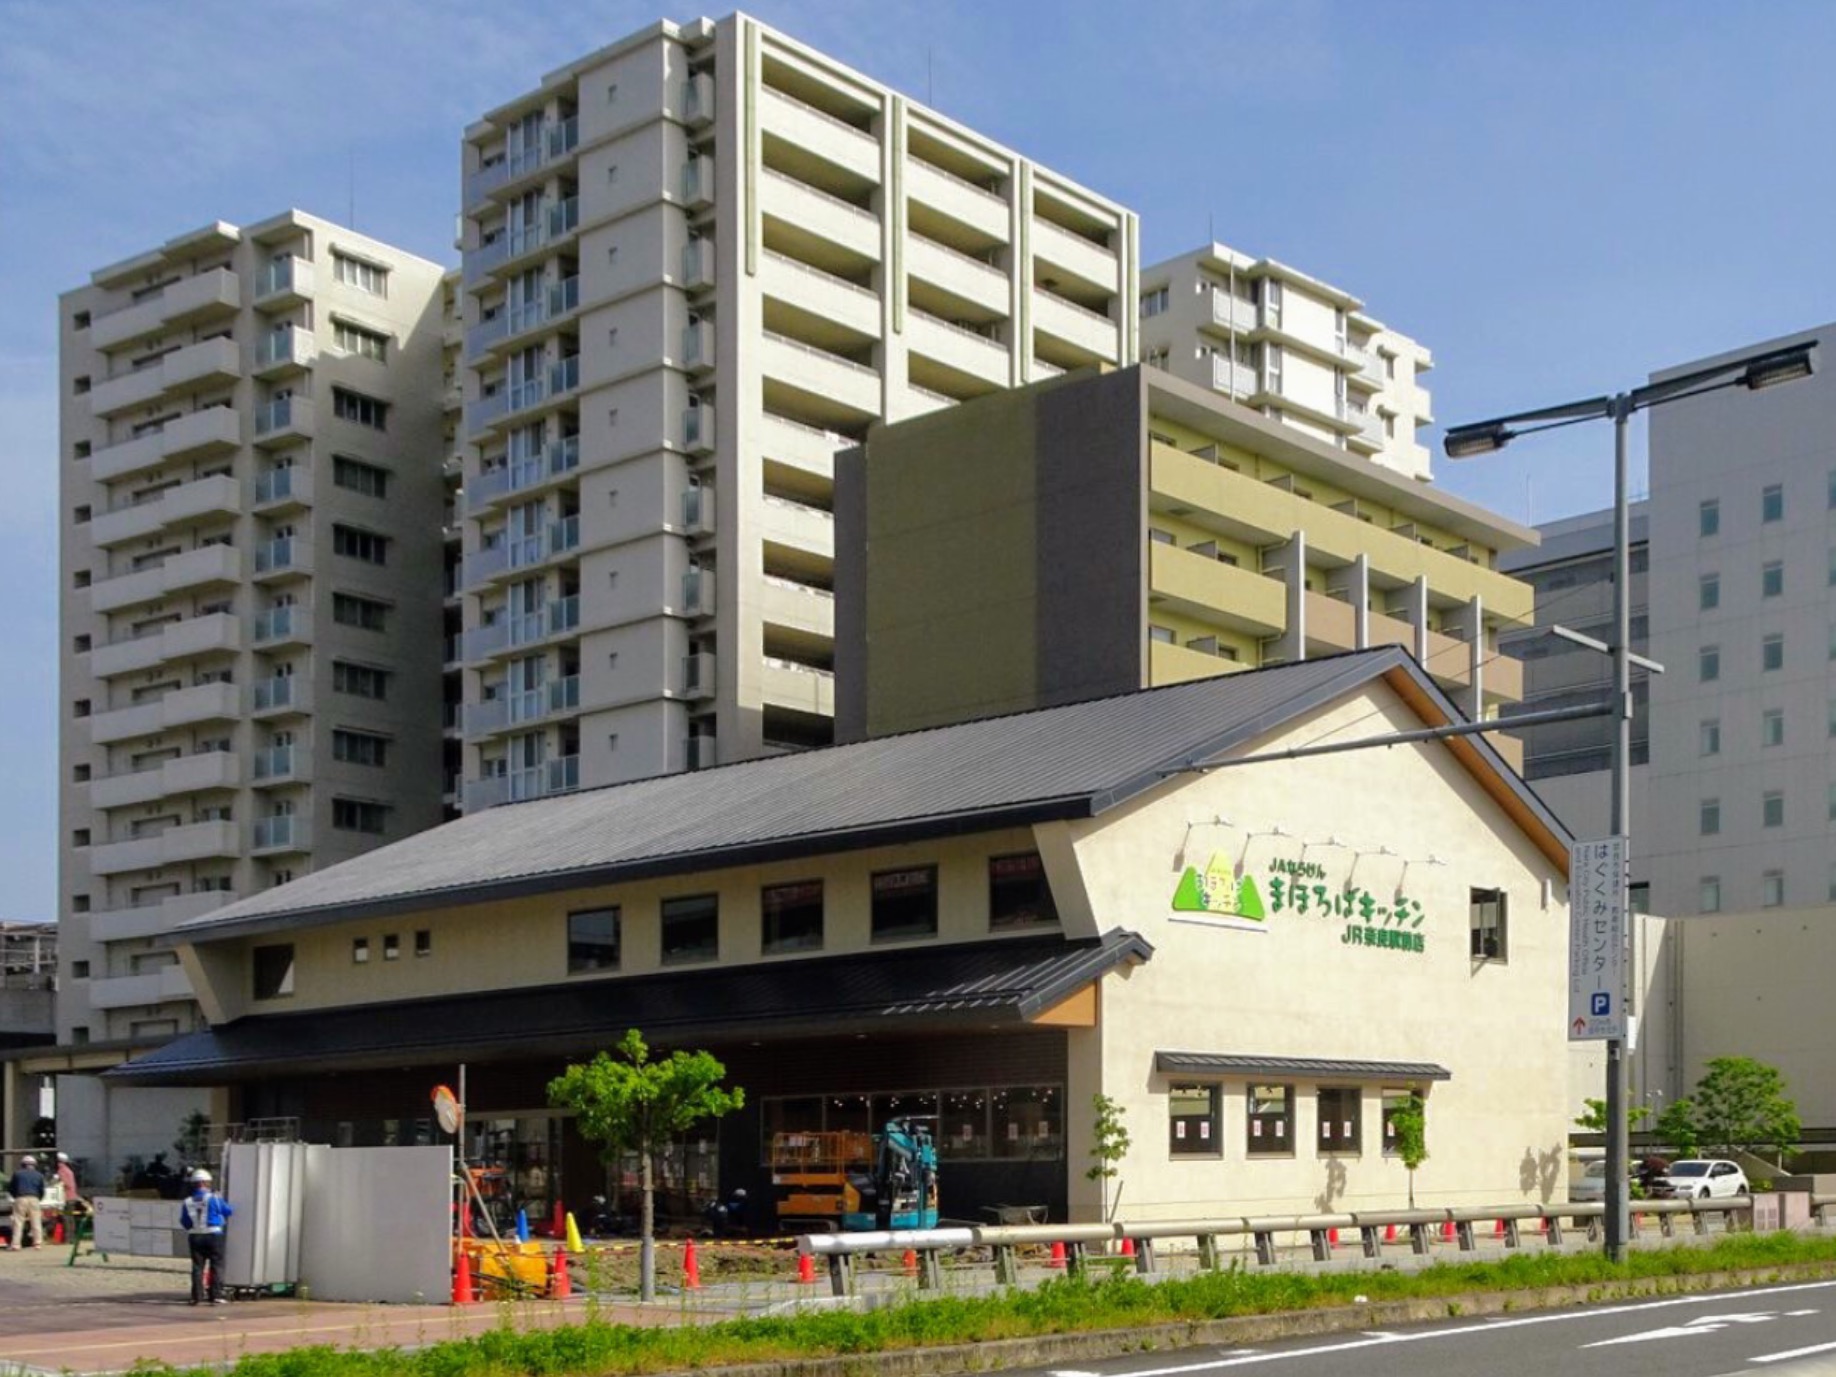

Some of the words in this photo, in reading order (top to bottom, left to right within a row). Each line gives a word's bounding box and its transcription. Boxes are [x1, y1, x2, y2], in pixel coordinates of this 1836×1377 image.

[1269, 858, 1326, 880] JAならけん
[1269, 876, 1425, 928] まほろばキッチン
[1341, 924, 1425, 953] JR奈良駅前店
